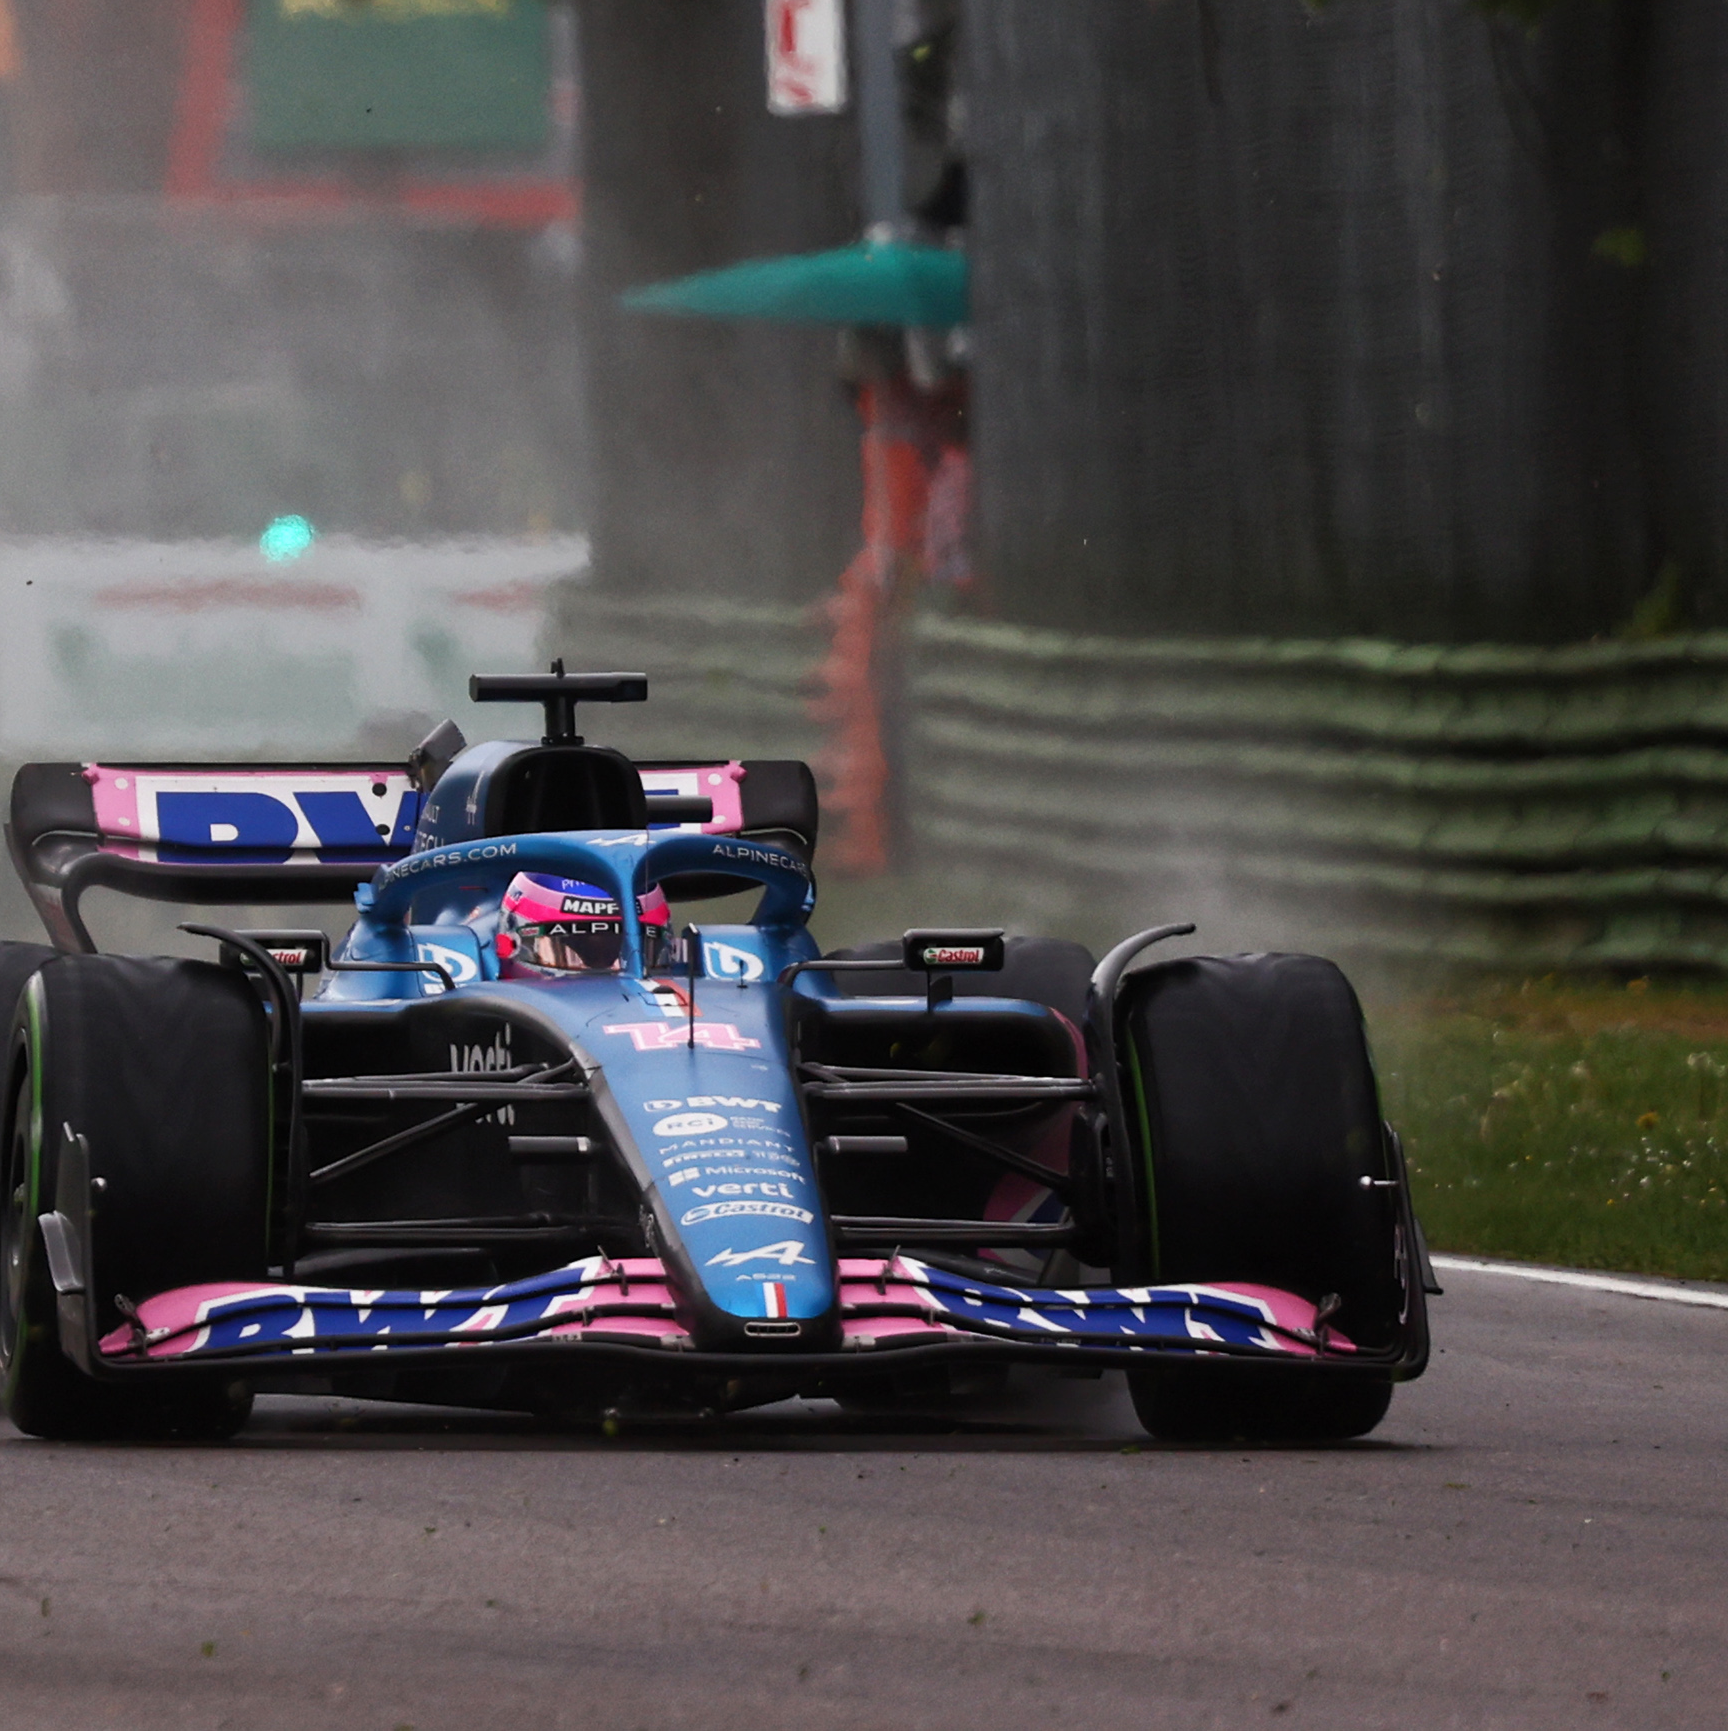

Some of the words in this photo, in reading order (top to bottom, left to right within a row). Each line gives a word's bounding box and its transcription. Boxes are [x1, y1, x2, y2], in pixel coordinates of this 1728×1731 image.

[549, 922, 657, 938] ALPIE
[938, 949, 980, 963] Castrol
[603, 1022, 761, 1052] 14
[686, 1095, 782, 1114] BWT
[659, 1137, 795, 1156] MANDIANT
[704, 1166, 807, 1185] Microsoft
[692, 1182, 794, 1199] verti
[713, 1202, 805, 1219] Castrol
[193, 1266, 589, 1356] BWT
